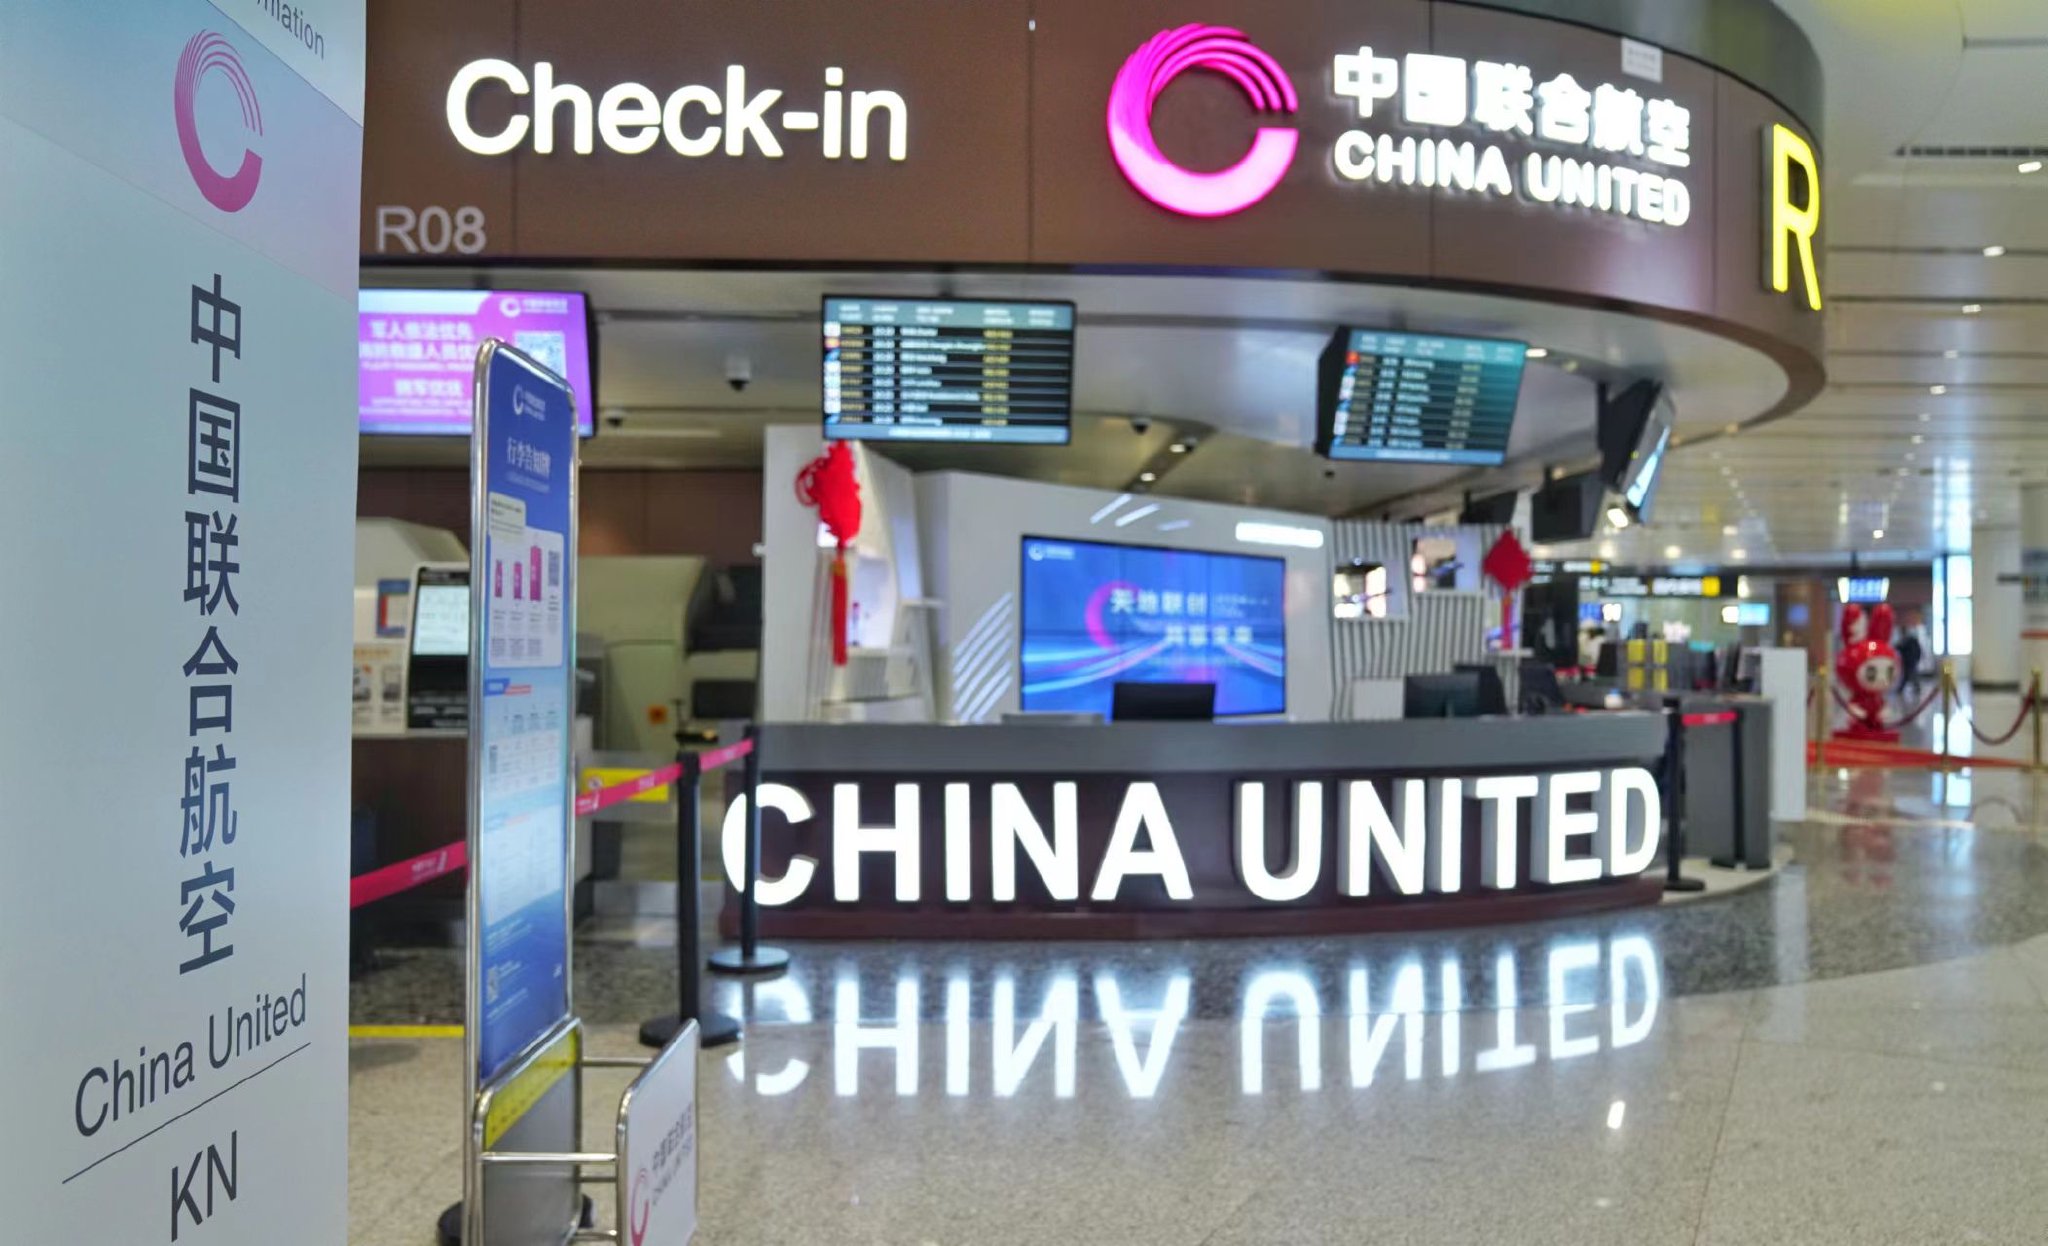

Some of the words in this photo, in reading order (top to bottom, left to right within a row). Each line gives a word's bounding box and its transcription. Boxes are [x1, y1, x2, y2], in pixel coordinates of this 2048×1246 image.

[256, 0, 324, 59] mation
[446, 59, 908, 161] Check-in
[377, 205, 487, 255] R08
[1333, 129, 1513, 196] CHINA
[1526, 151, 1691, 227] UNITED
[1769, 123, 1824, 311] R
[178, 273, 243, 975] 中国联合航空
[722, 781, 1194, 906] CHINA
[1237, 766, 1662, 904] UNITED
[75, 1041, 195, 1137] China
[208, 972, 306, 1069] United
[170, 1129, 238, 1243] KN
